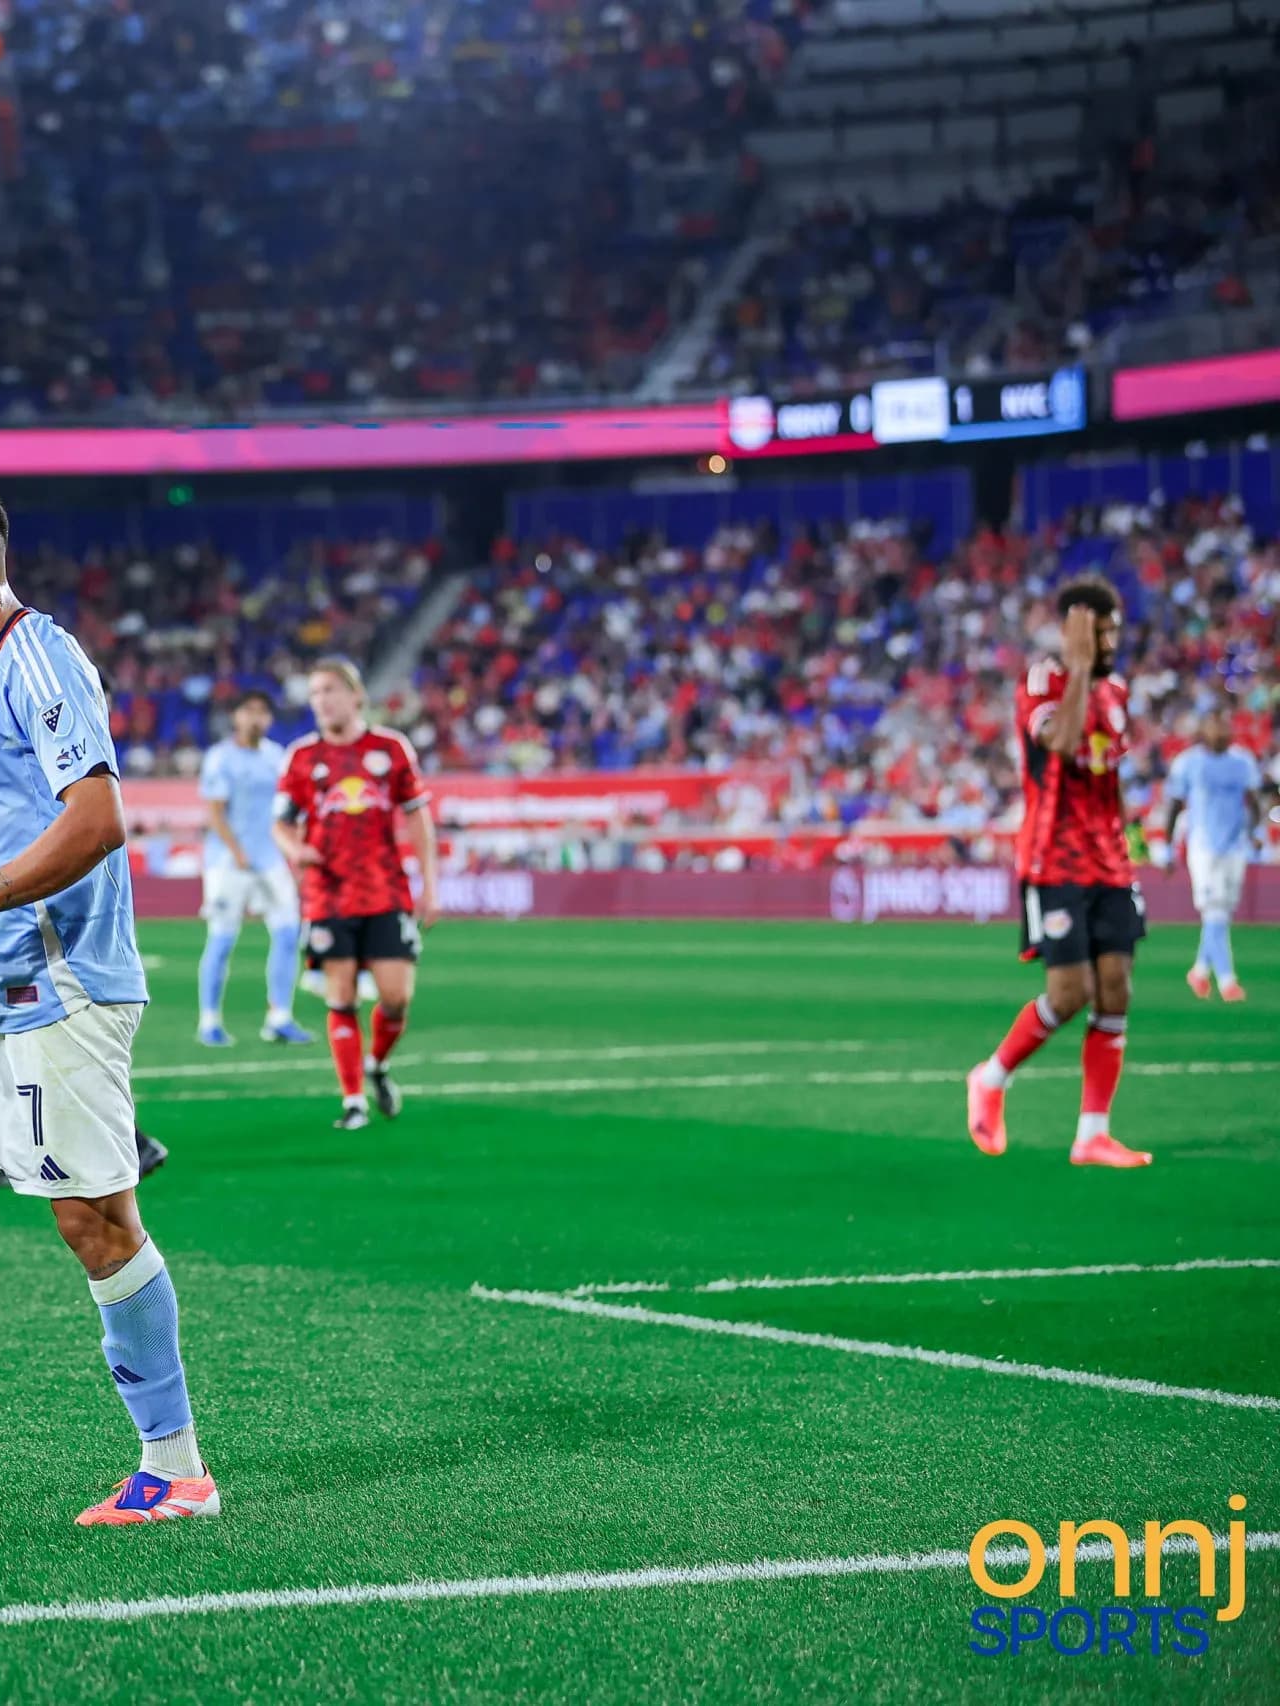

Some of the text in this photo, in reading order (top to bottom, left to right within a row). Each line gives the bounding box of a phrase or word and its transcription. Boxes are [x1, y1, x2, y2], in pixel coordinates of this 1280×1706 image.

[43, 708, 59, 721] MLS
[71, 738, 86, 761] tv
[16, 1084, 44, 1146] 7
